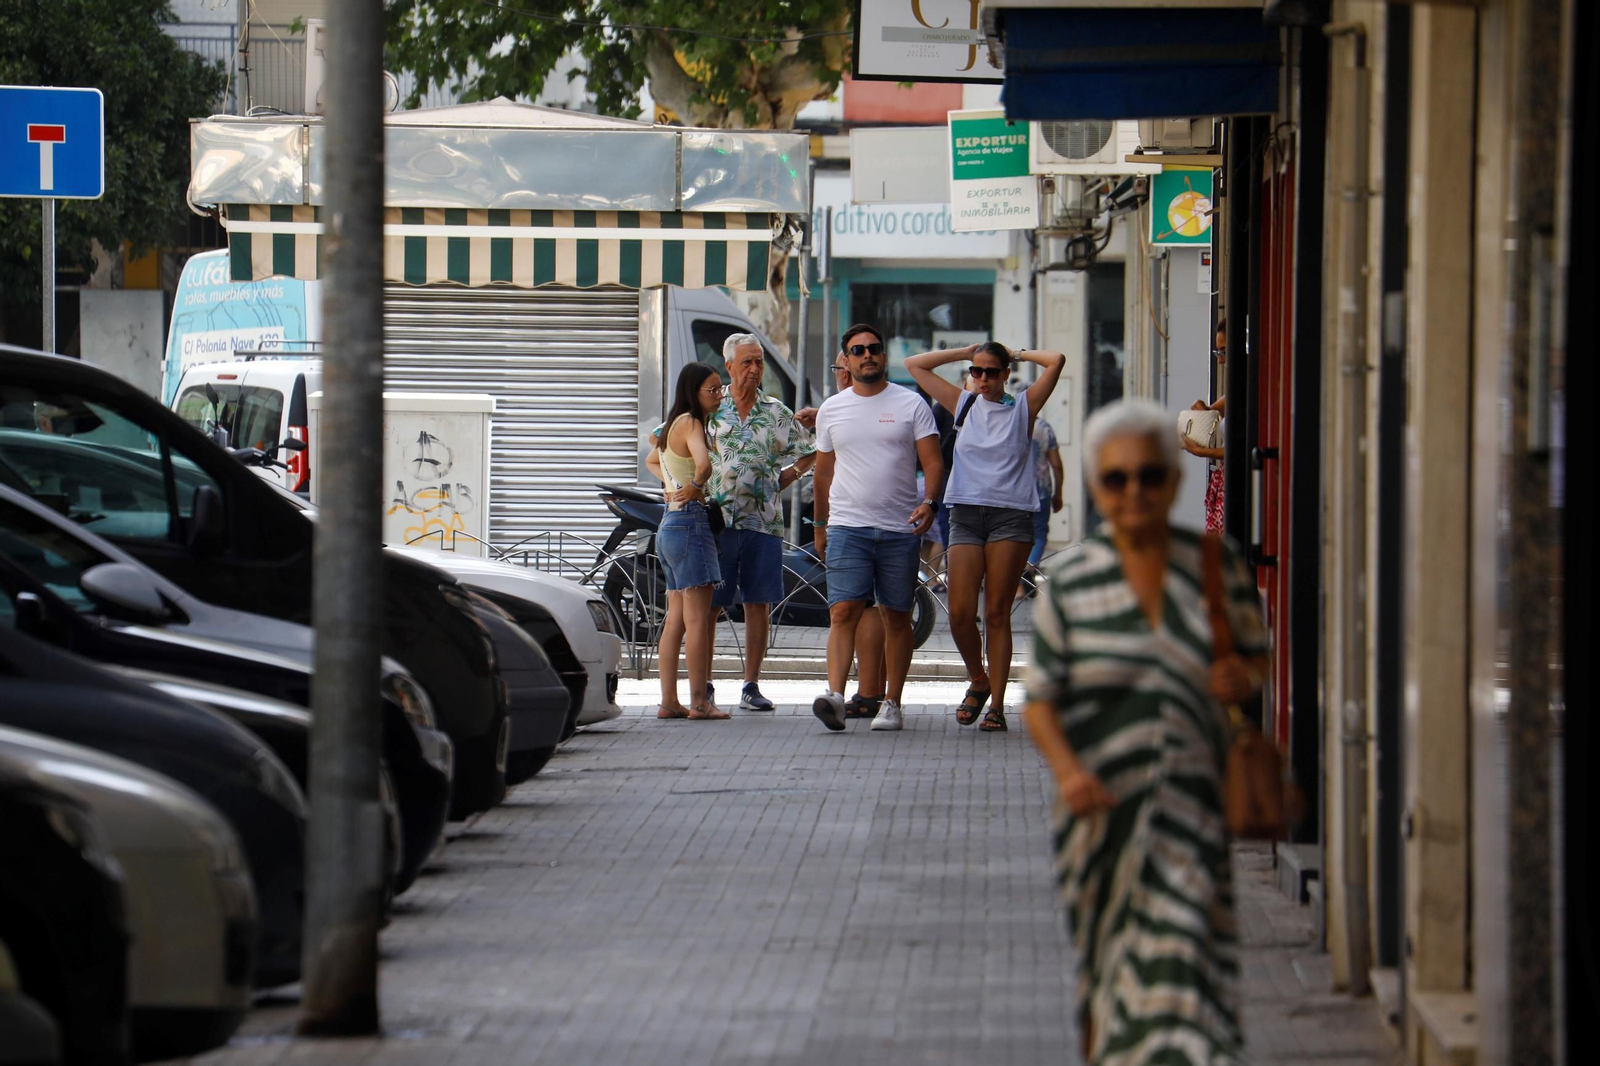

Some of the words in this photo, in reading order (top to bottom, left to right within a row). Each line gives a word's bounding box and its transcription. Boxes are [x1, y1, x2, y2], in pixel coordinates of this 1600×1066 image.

[955, 134, 1027, 148] EXPORTUR
[957, 148, 981, 156] Agencia
[992, 146, 1014, 155] Viajes
[966, 187, 1022, 199] EXPORTUR
[960, 206, 1031, 218] INMOBILIARIA
[209, 285, 250, 303] muebles
[252, 287, 260, 302] y
[261, 283, 284, 299] más
[184, 340, 194, 356] C/
[196, 338, 227, 353] Polonia
[230, 335, 255, 351] Nave
